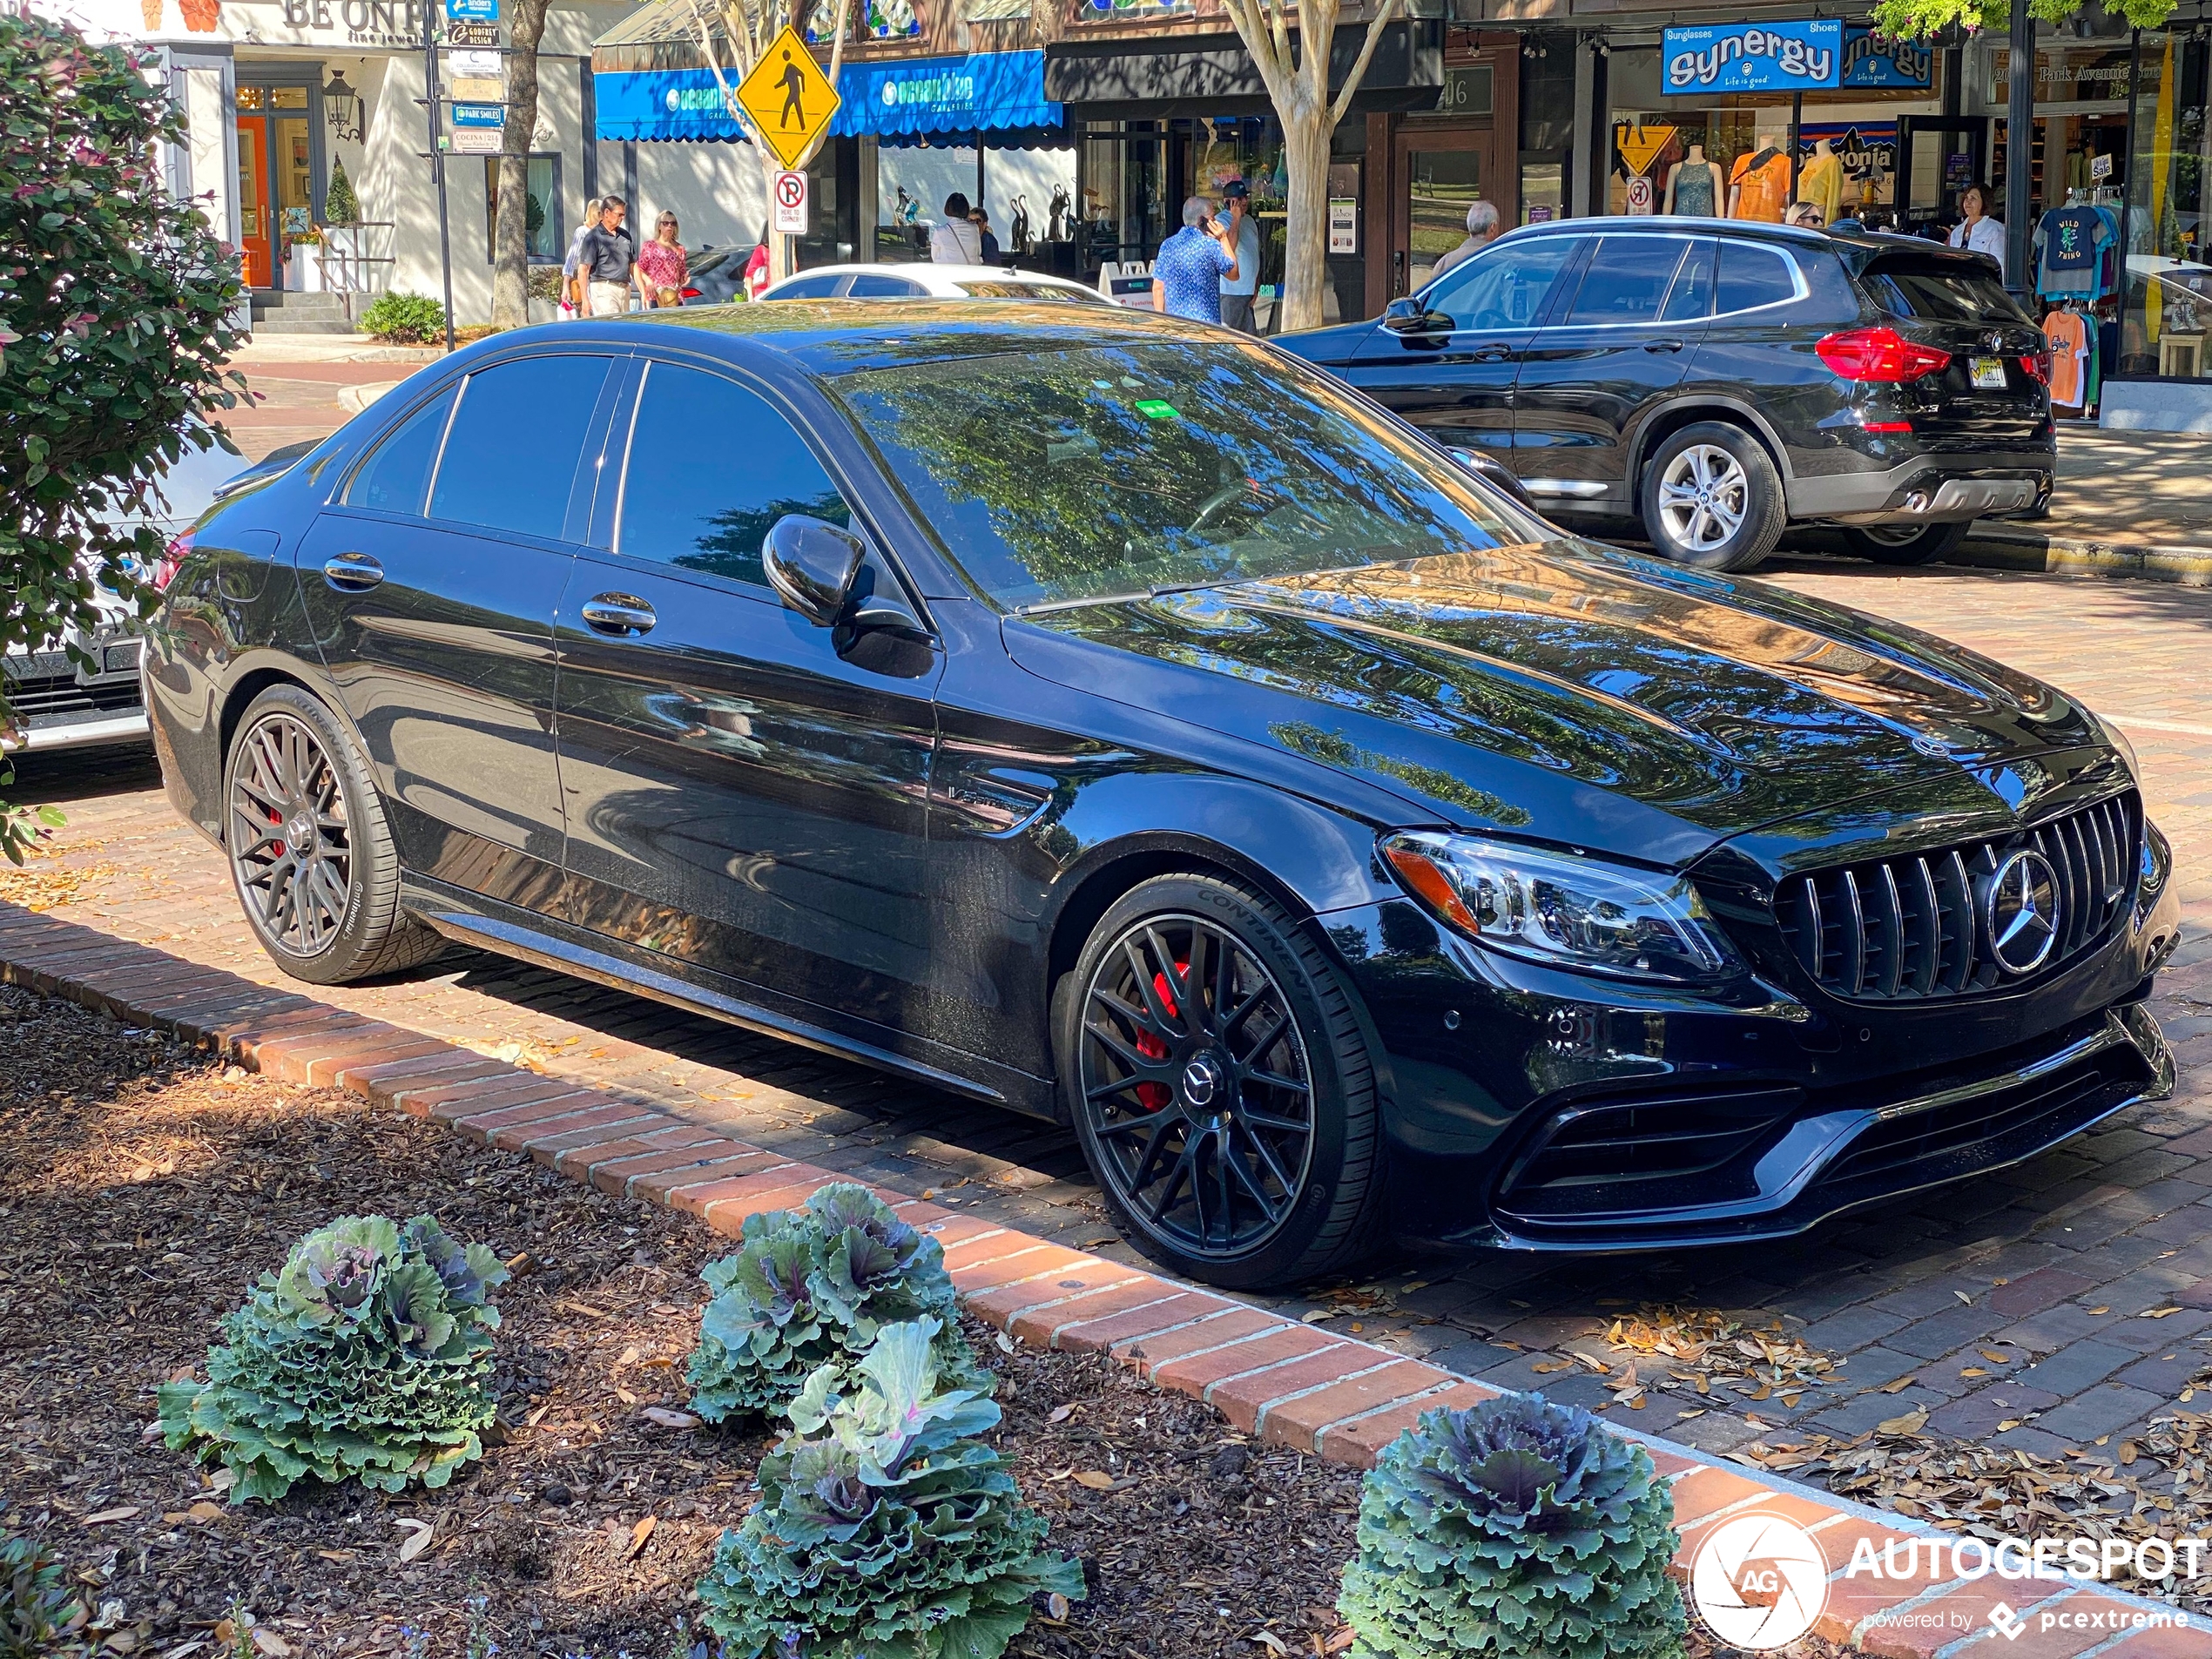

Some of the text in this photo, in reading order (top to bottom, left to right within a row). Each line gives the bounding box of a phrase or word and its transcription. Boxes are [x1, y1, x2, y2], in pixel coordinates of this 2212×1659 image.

[469, 27, 497, 37] GODFREY
[1667, 23, 1838, 42] Sunglasses Shoes
[469, 36, 492, 44] DESIGN
[1844, 36, 1929, 82] ynergy
[1873, 73, 1886, 84] good
[2039, 66, 2071, 82] Park
[2074, 65, 2129, 80] Avenue
[1749, 75, 1767, 89] good
[930, 102, 973, 112] GALLERIES
[465, 109, 499, 119] PARK SMILES
[487, 134, 499, 143] 214
[2093, 165, 2111, 177] Sale
[2059, 220, 2079, 229] WILD
[2058, 251, 2081, 260] THING
